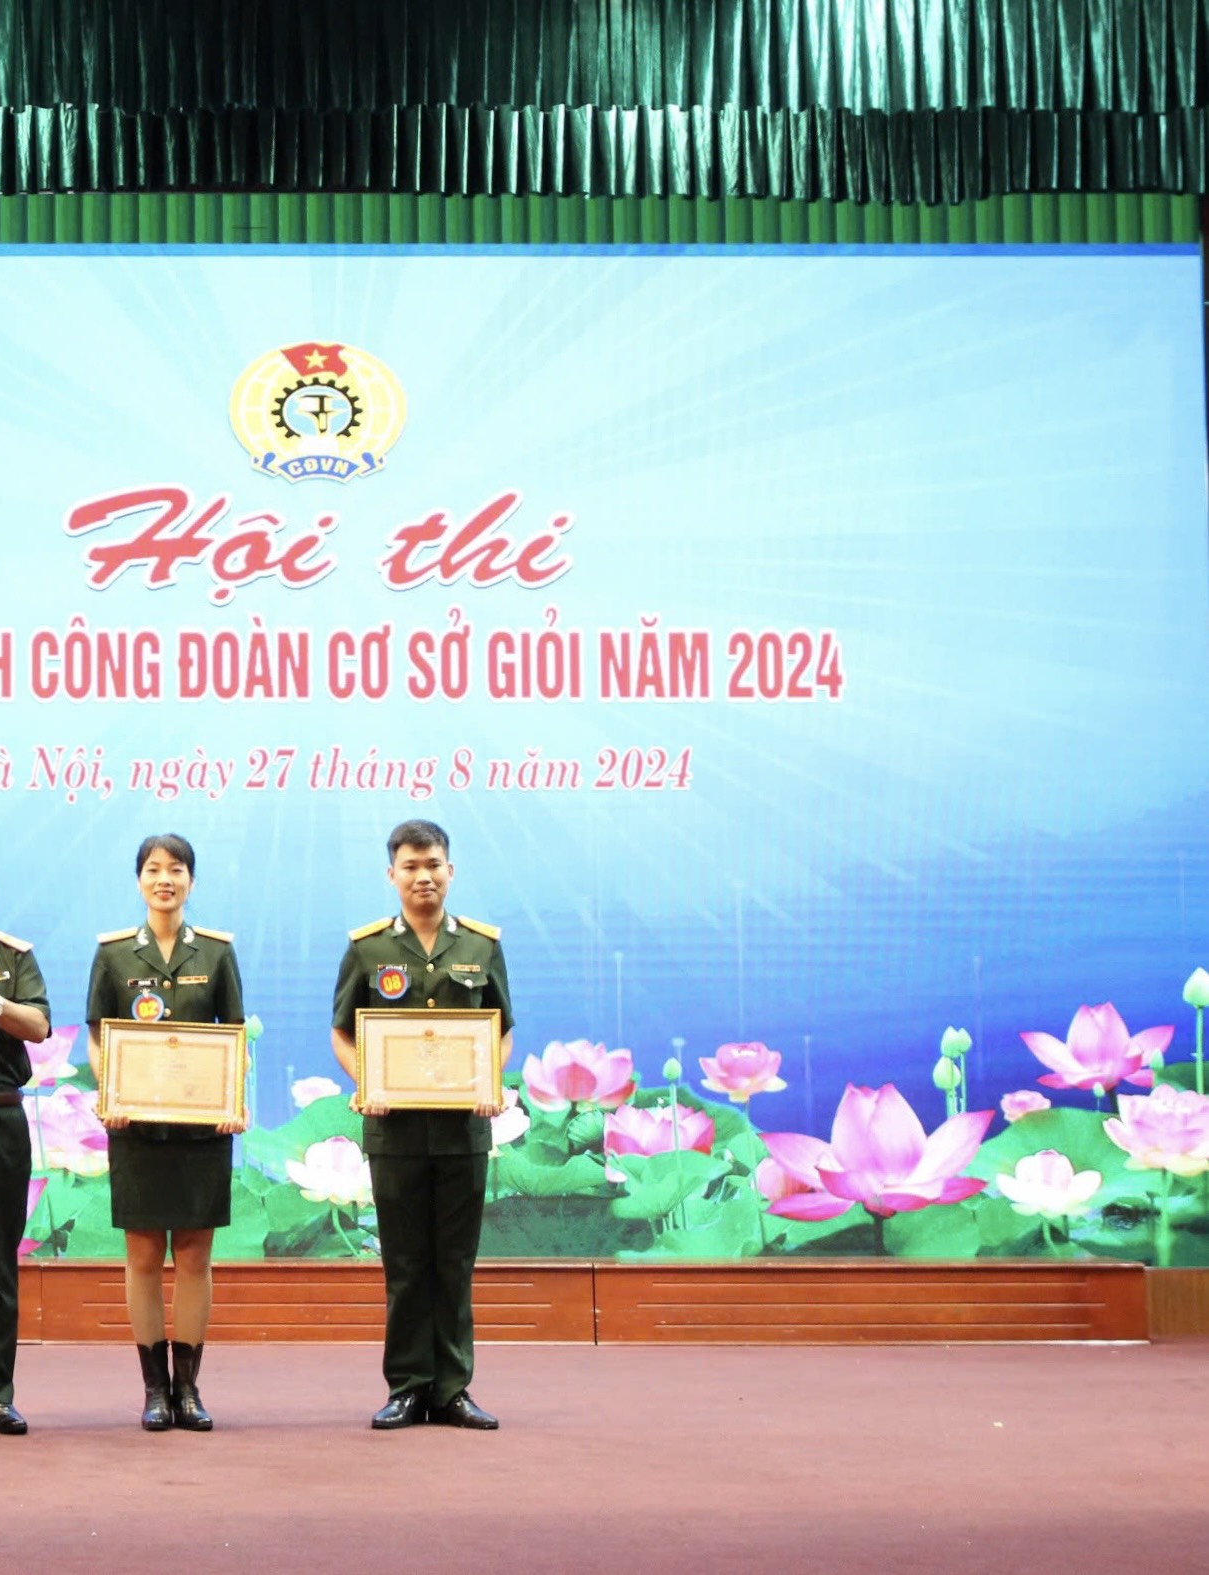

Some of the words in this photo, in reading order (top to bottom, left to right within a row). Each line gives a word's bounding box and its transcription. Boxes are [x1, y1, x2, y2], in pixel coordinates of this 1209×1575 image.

[65, 485, 338, 602] Hội
[378, 490, 571, 586] thi
[30, 615, 162, 700] CÔNG
[176, 615, 310, 700] ĐOÀN
[326, 624, 392, 700] CƠ
[406, 606, 471, 700] SỞ
[487, 606, 582, 700] GIỎI
[598, 614, 711, 700] NĂM
[726, 630, 844, 700] 2024
[27, 746, 112, 803] Nội,
[129, 748, 234, 800] ngày
[245, 748, 296, 790] 27
[308, 747, 438, 799] tháng
[448, 747, 474, 790] 8
[487, 749, 582, 790] năm
[593, 747, 693, 790] 2024
[383, 975, 402, 992] 08
